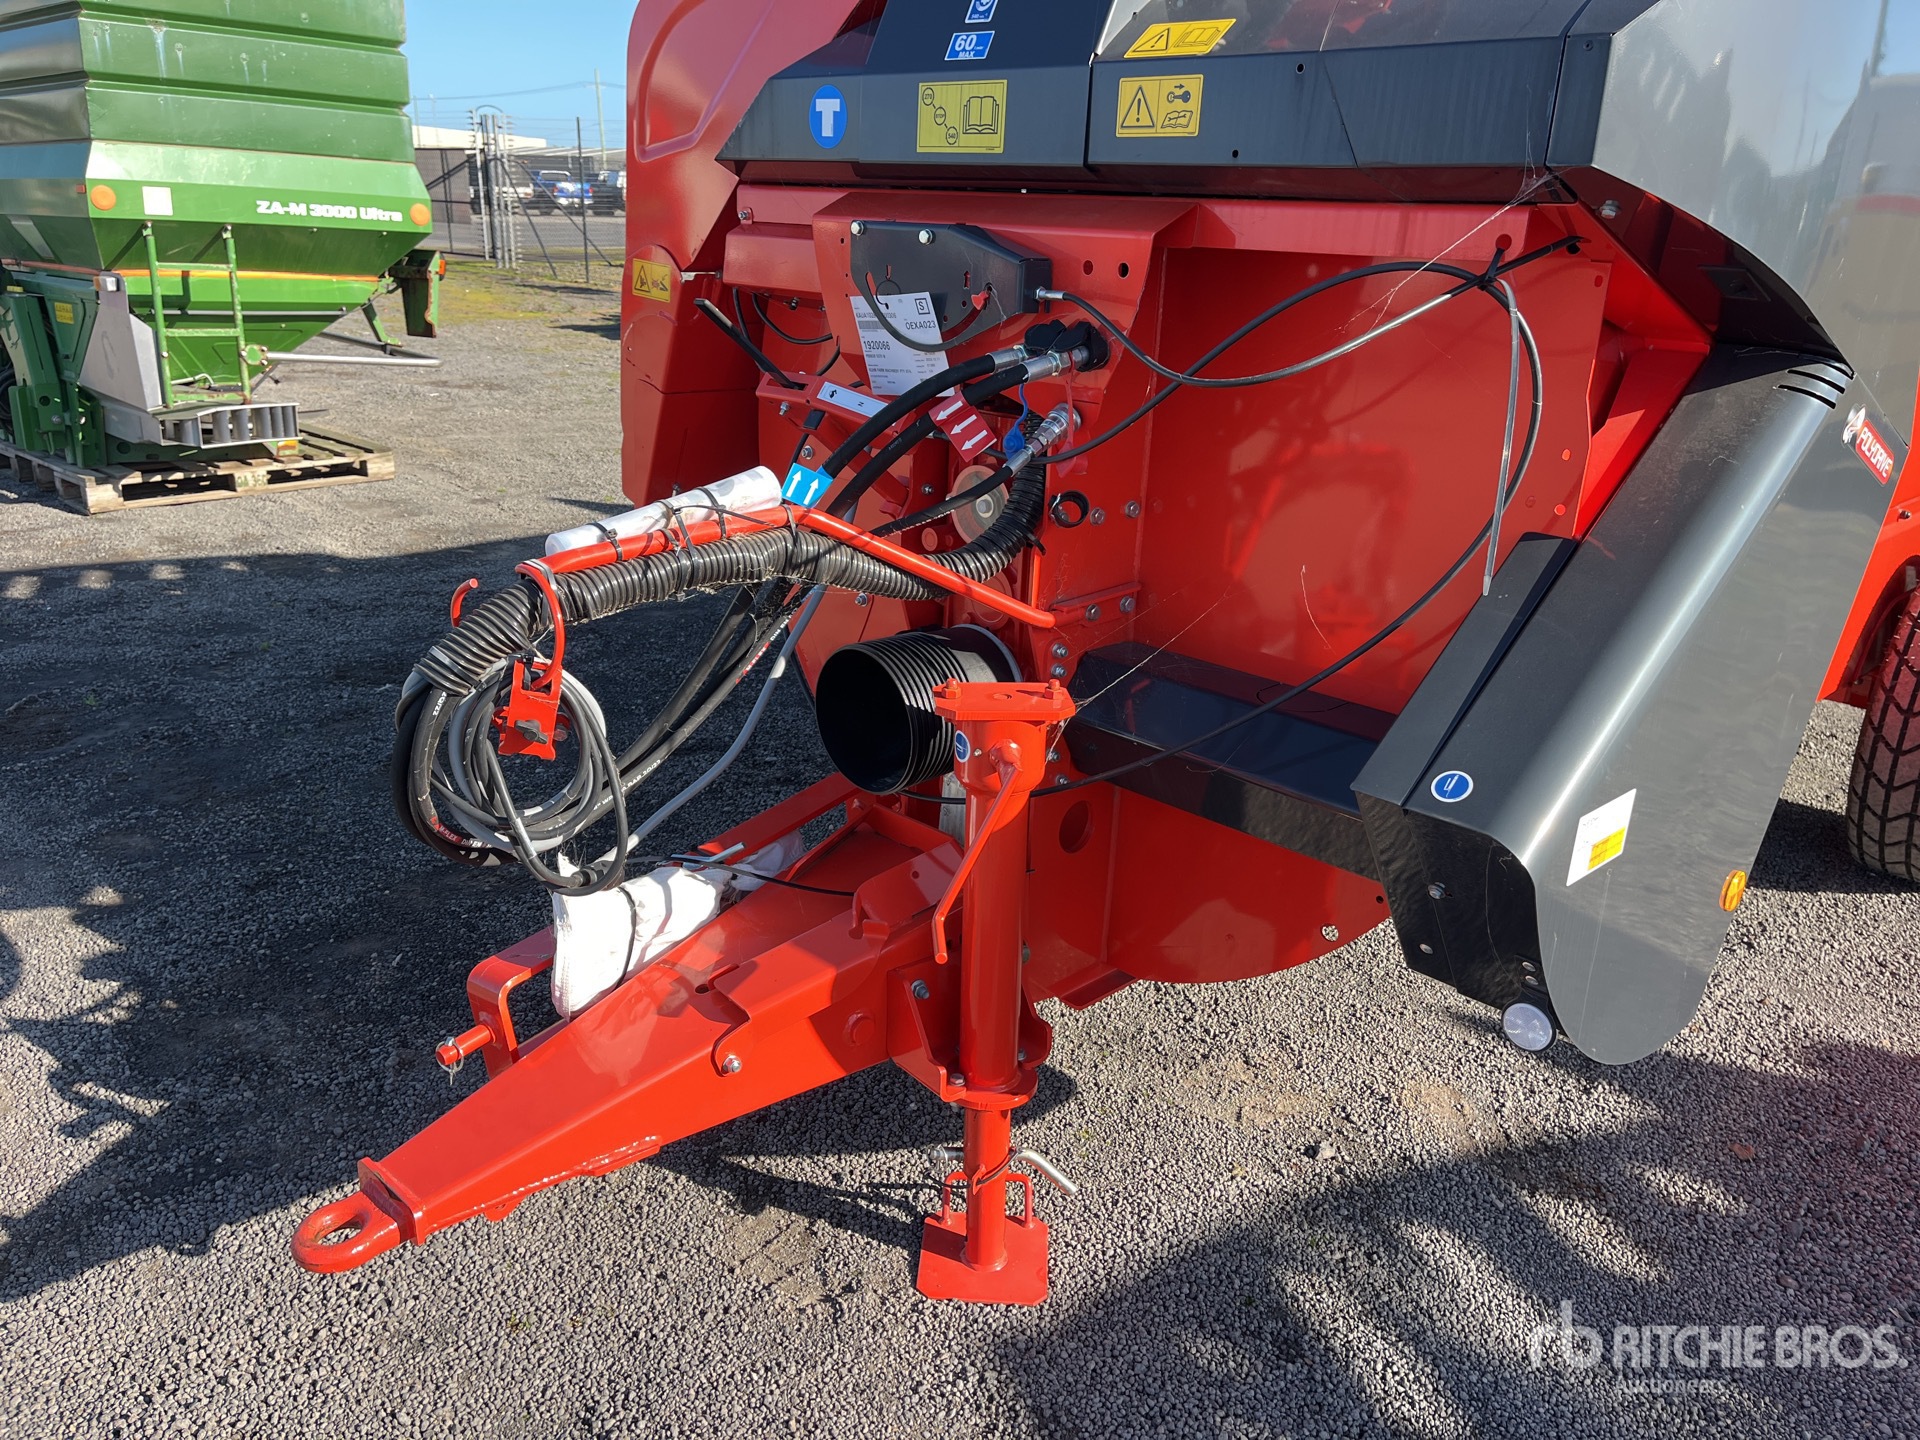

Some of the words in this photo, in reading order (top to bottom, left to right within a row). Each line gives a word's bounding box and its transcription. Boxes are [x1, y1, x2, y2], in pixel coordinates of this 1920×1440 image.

[955, 34, 977, 51] 60
[958, 50, 976, 58] MAX
[256, 200, 307, 216] ZA-M
[309, 203, 358, 219] 3000
[359, 206, 403, 222] Ultra
[918, 300, 925, 311] S
[863, 340, 891, 351] 1920066
[1857, 426, 1893, 478] POLYDRIVE
